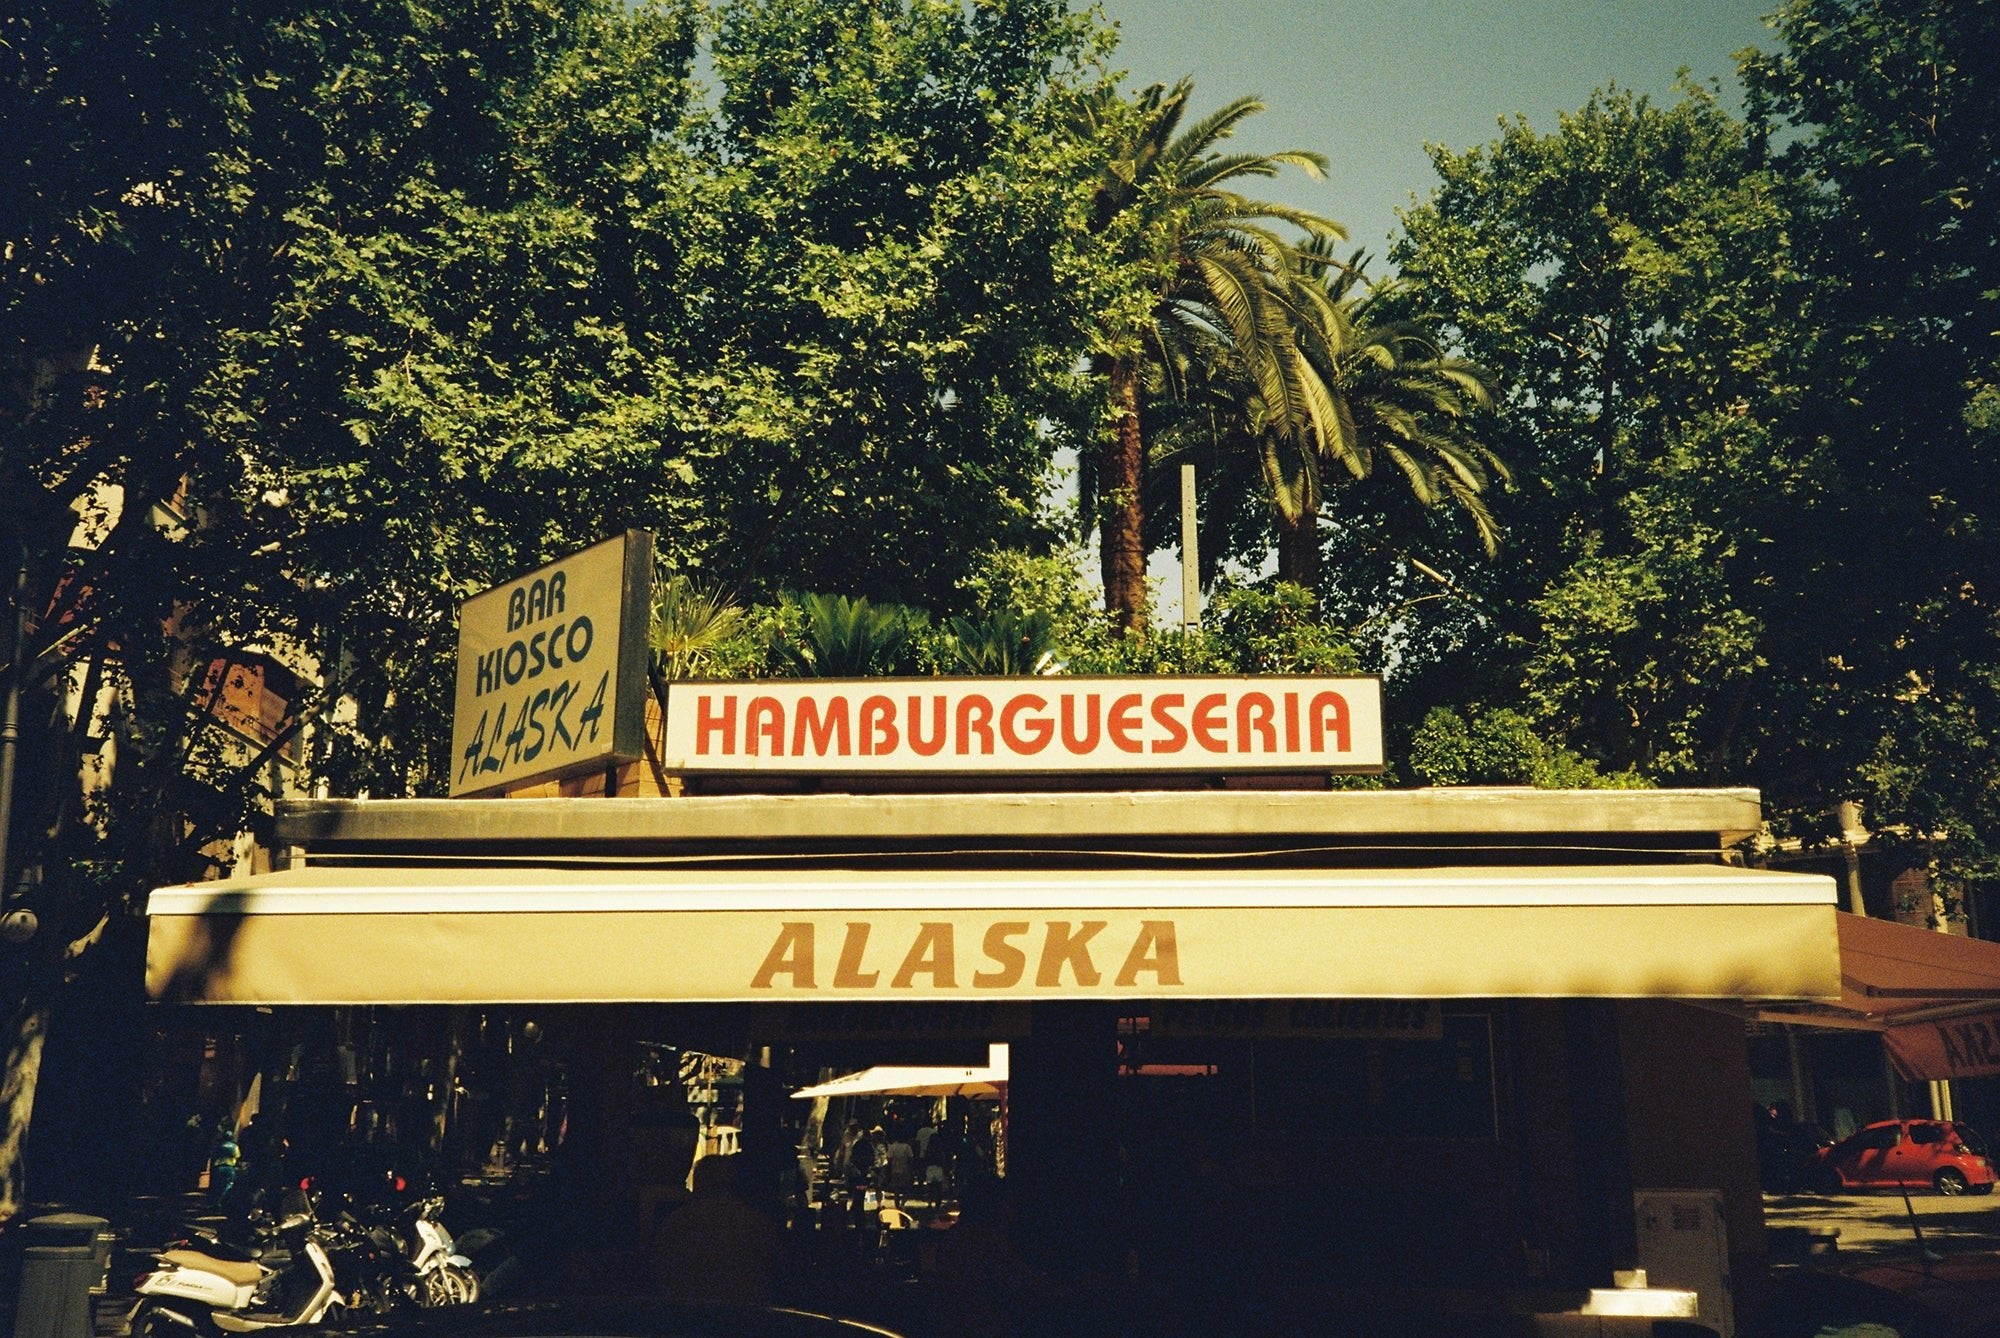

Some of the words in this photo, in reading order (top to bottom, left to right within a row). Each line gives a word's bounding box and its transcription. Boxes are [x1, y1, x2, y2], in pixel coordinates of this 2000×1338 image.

[507, 571, 566, 633] BAR
[476, 615, 593, 697] KIOSCO
[459, 669, 609, 785] ALASKA
[695, 690, 1351, 757] HAMBURGUESERIA
[750, 920, 1184, 989] ALASKA
